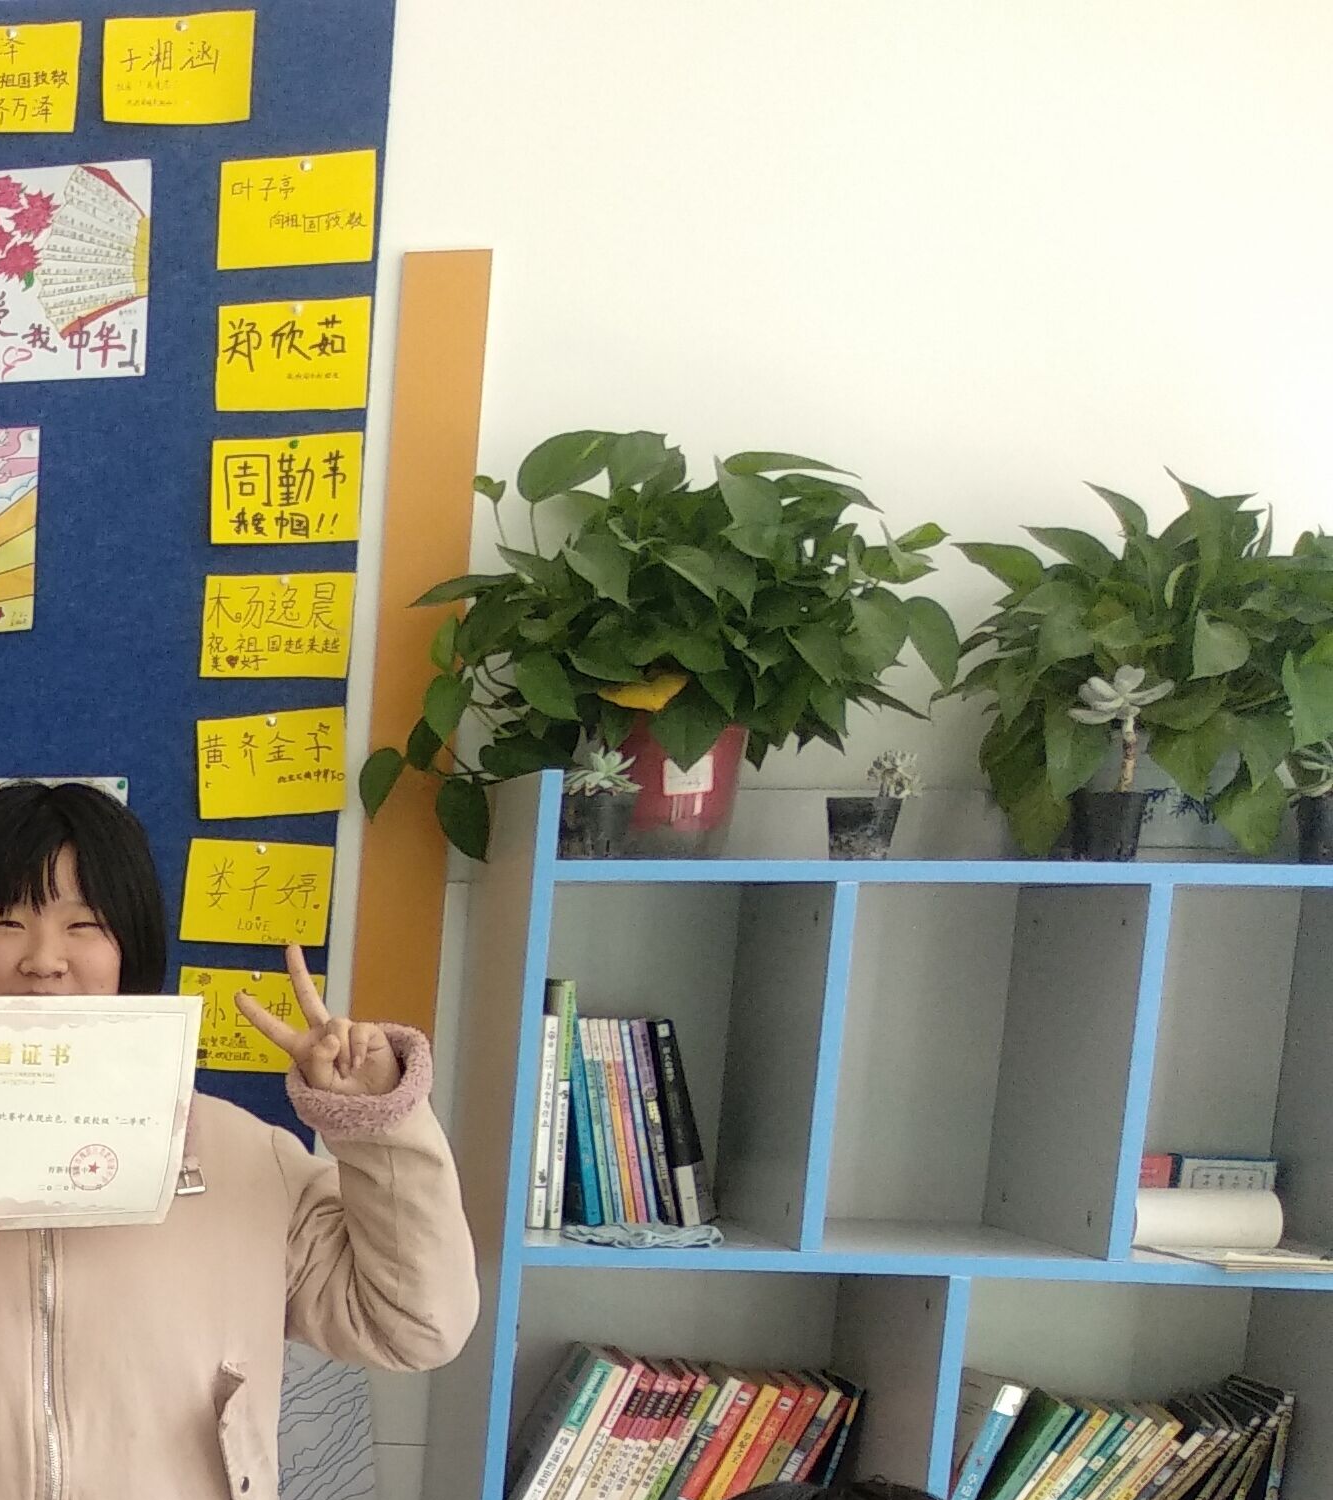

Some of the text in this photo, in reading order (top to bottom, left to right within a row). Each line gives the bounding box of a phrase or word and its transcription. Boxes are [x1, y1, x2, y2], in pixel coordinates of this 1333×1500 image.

[231, 175, 297, 202] 叶子亭
[222, 314, 348, 373] 郑欣茹
